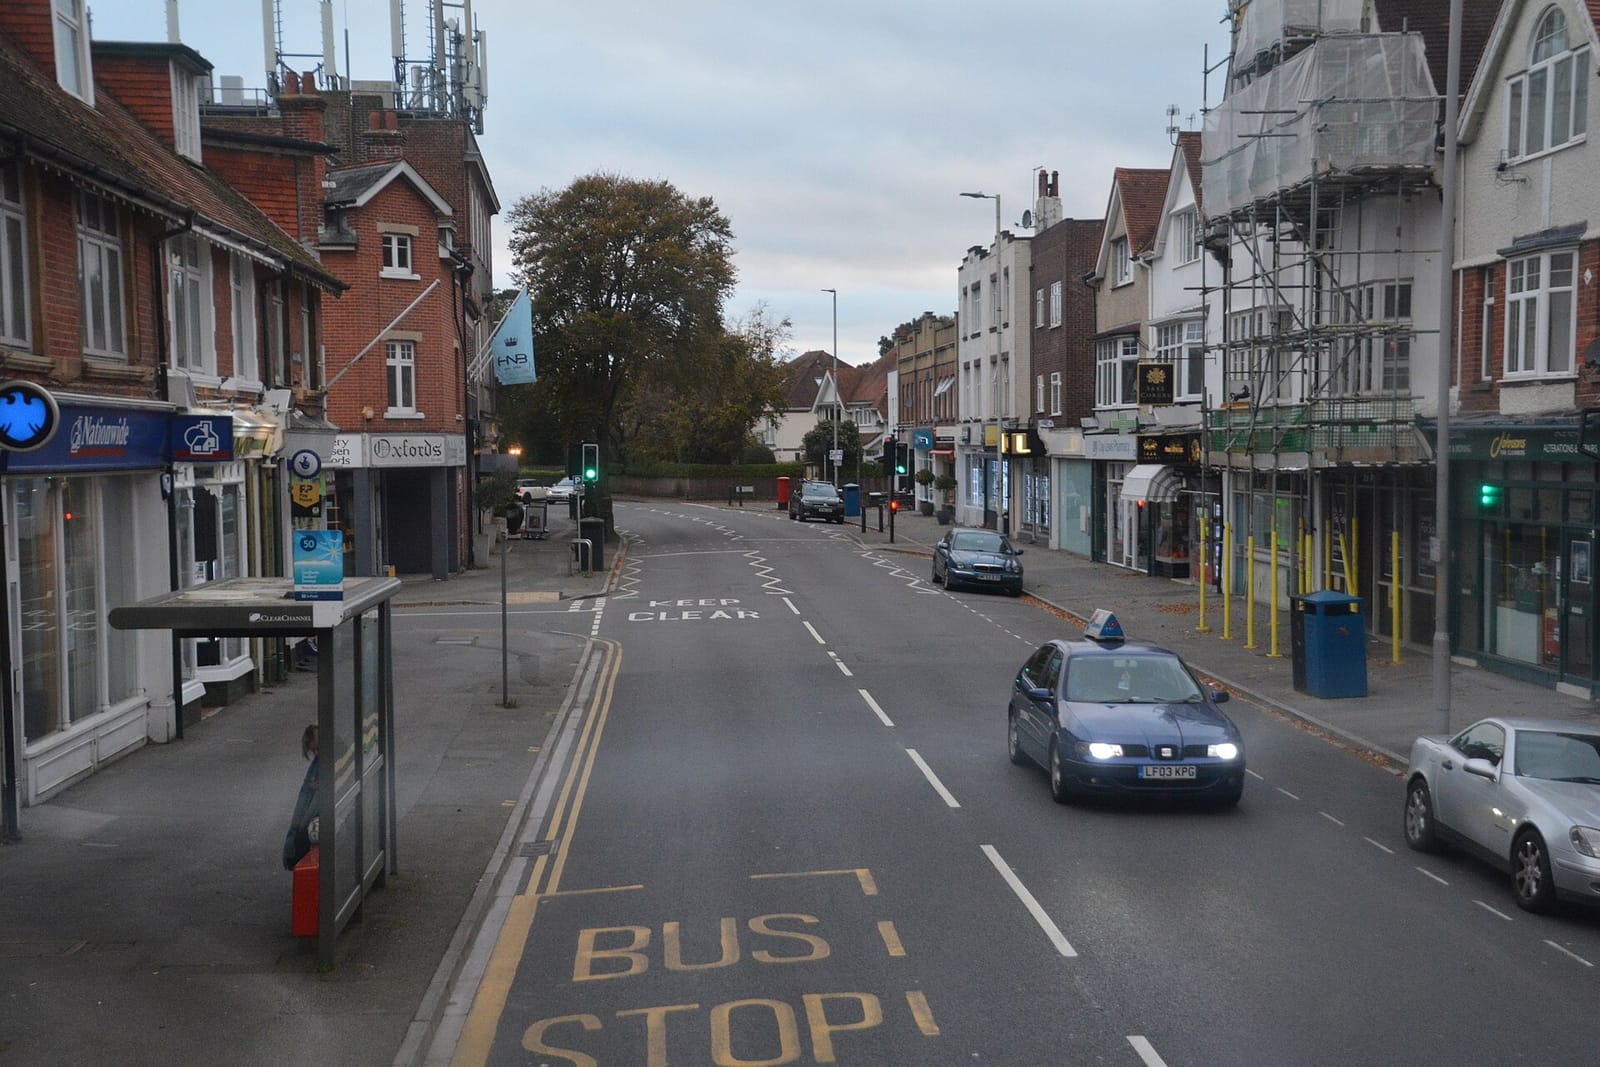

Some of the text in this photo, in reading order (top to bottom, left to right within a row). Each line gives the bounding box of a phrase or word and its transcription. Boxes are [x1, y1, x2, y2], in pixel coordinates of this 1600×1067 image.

[498, 353, 528, 366] HNB
[82, 415, 129, 446] Nationwide
[373, 438, 442, 458] Oxfords
[303, 539, 316, 549] 50
[650, 598, 740, 607] KEEP
[628, 610, 761, 622] CLEAR
[1145, 766, 1195, 777] LF03 KPG
[572, 912, 831, 983] BUS
[521, 991, 884, 1067] STOP
